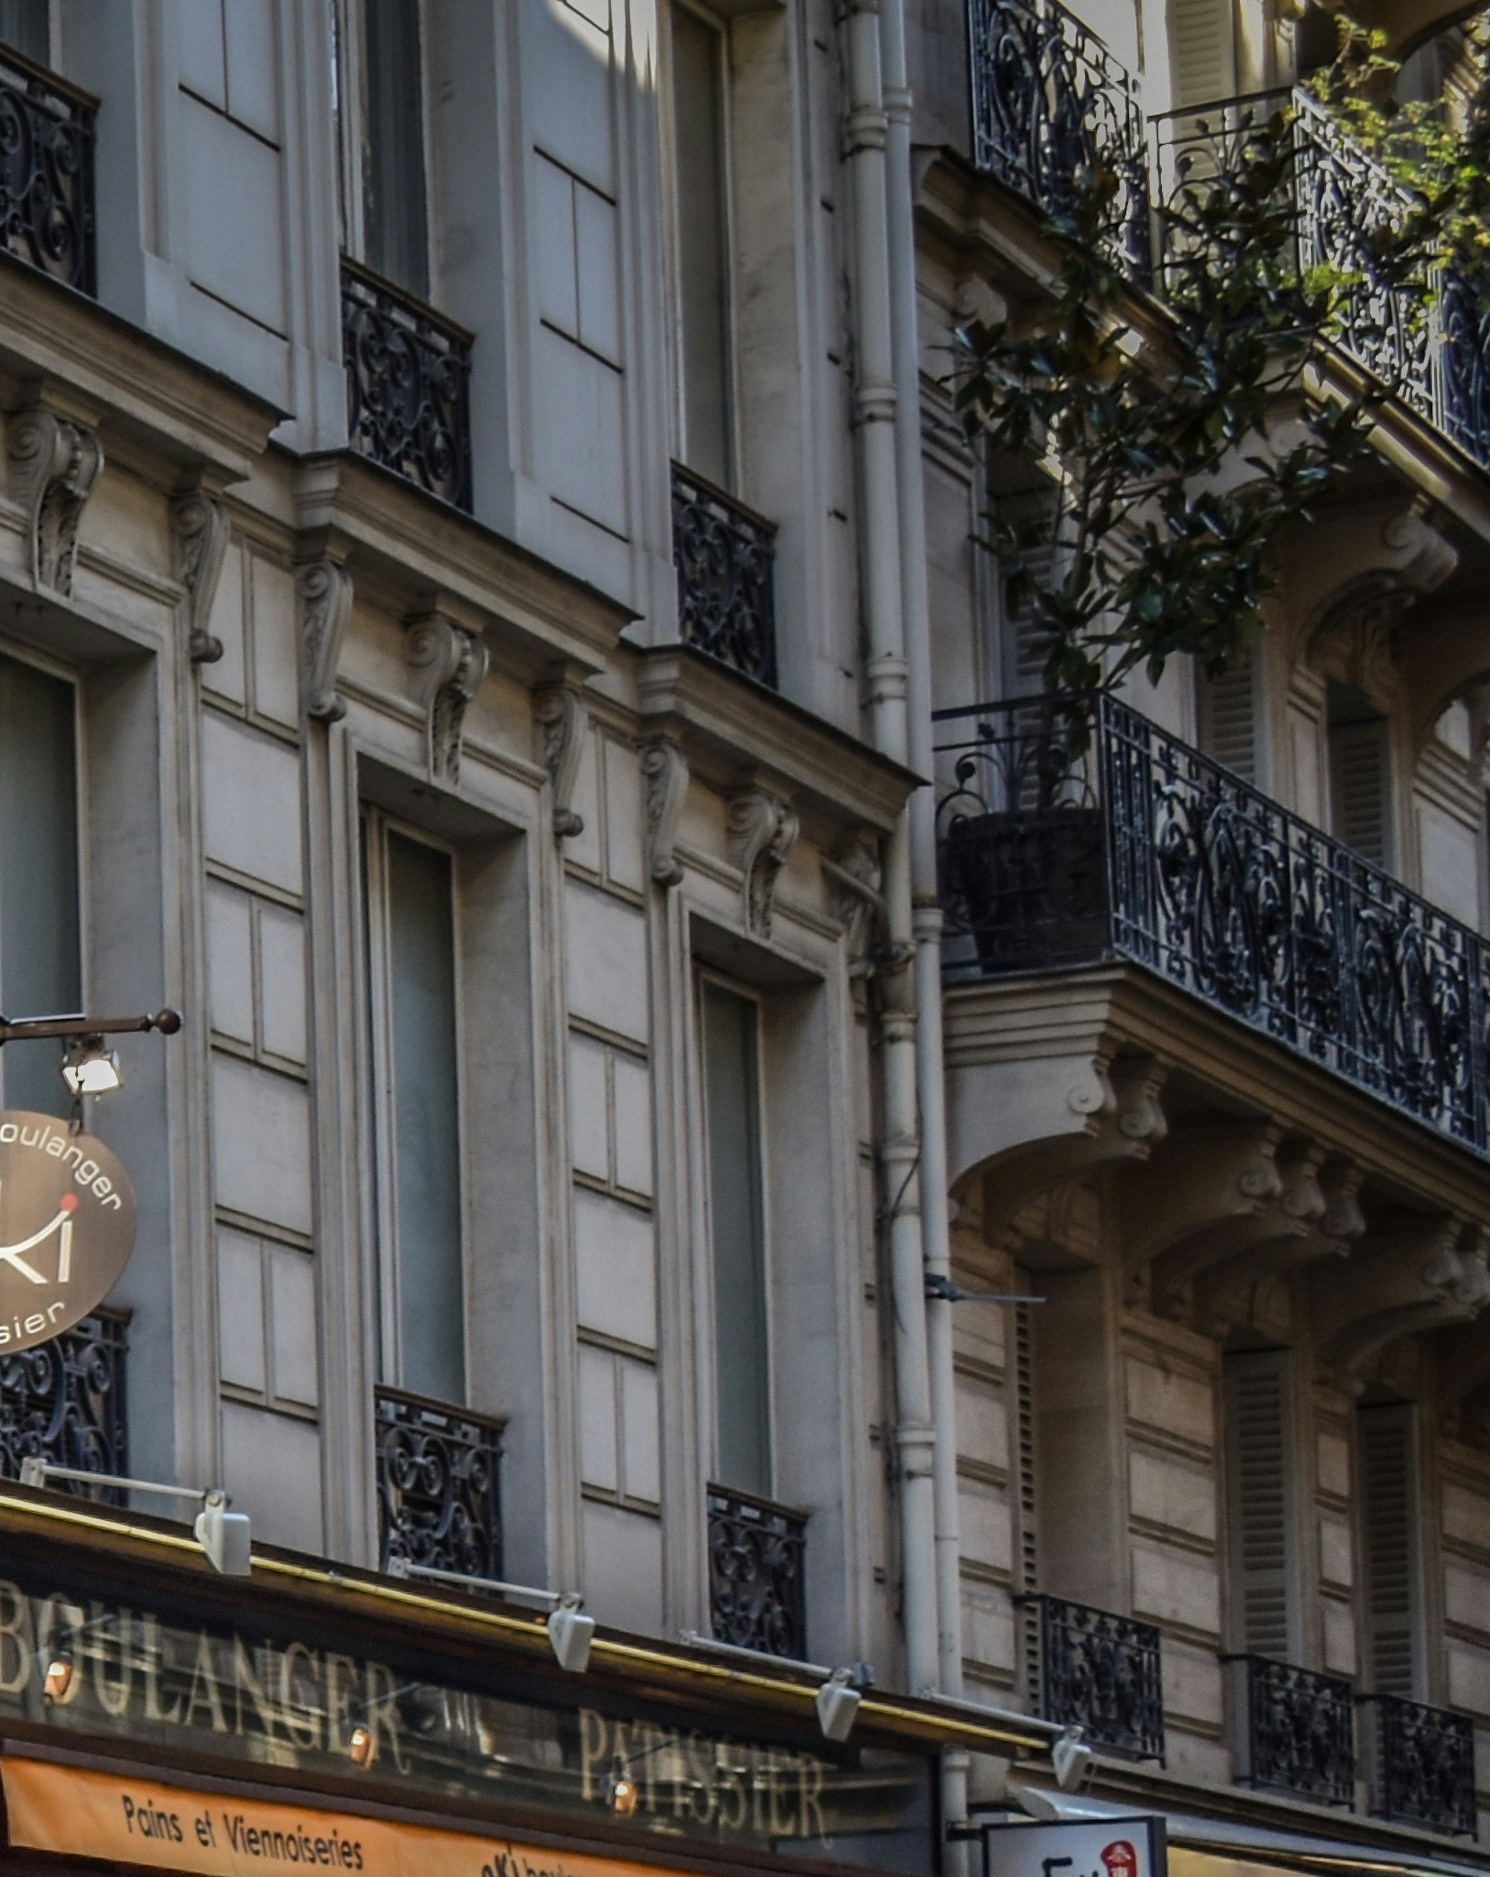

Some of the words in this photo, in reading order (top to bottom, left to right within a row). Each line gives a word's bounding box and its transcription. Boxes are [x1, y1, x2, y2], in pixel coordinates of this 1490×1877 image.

[122, 1794, 184, 1844] Pains
[194, 1813, 215, 1847] et
[225, 1816, 365, 1873] Viennoiseries
